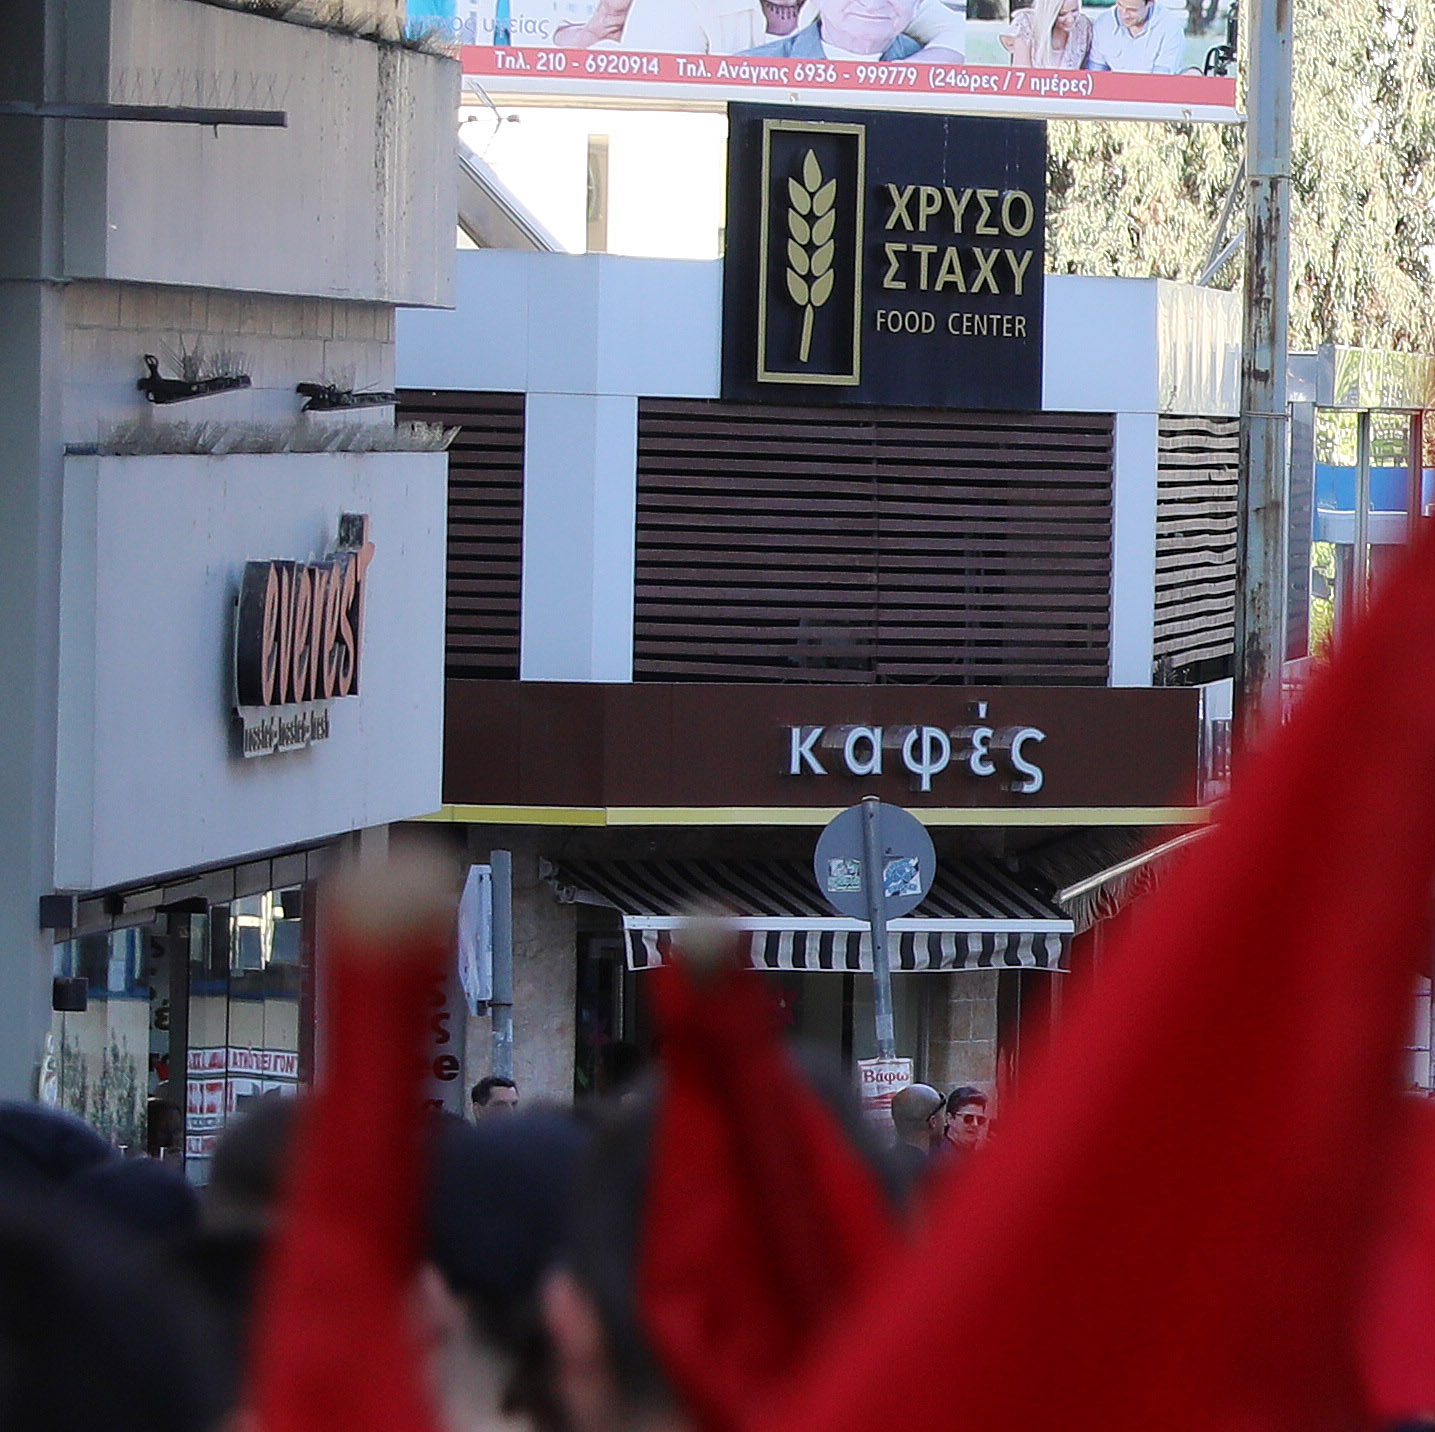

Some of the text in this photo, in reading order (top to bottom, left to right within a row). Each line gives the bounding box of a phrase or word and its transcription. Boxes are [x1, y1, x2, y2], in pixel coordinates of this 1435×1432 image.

[494, 50, 531, 71] Τηλ.
[536, 51, 566, 72] 210
[584, 54, 660, 75] 6920914
[676, 57, 712, 79] Τηλ.
[716, 58, 790, 85] Ανάγκης
[793, 61, 838, 85] 6936
[855, 64, 918, 87] 999779
[1015, 71, 1027, 90] 7
[1030, 71, 1094, 96] ημέρες)
[883, 182, 1035, 238] ΧΡΥΣΟ
[882, 241, 1034, 296] ΣΤΑΧΥ
[876, 309, 1027, 338] FOOD CENTER
[786, 702, 1048, 794] καφές
[863, 1070, 910, 1085] Βάφω
